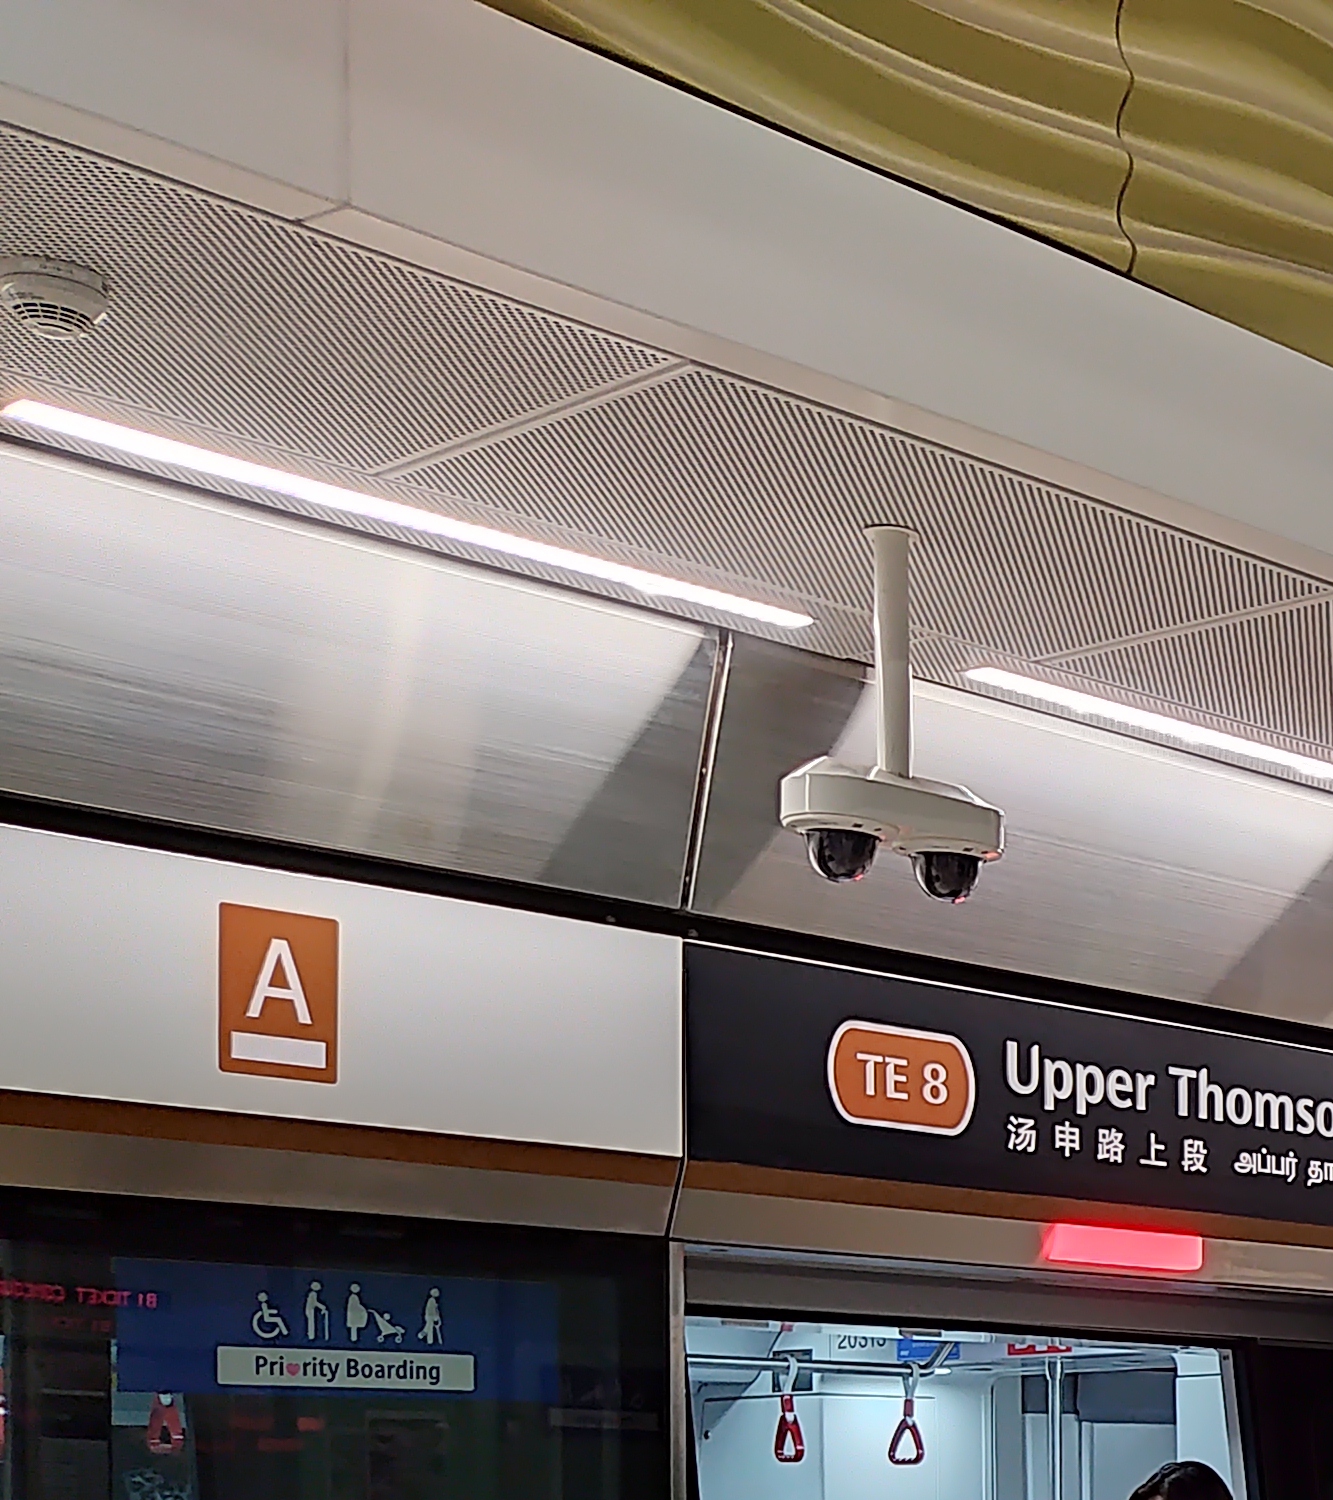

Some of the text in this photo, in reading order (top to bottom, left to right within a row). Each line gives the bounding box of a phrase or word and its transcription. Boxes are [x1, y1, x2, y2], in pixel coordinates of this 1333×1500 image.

[244, 937, 313, 1026] A
[855, 1051, 950, 1106] TE 8
[1005, 1039, 1155, 1117] Upper
[1006, 1115, 1209, 1174] 汤申路上段
[346, 1358, 441, 1386] Boarding
